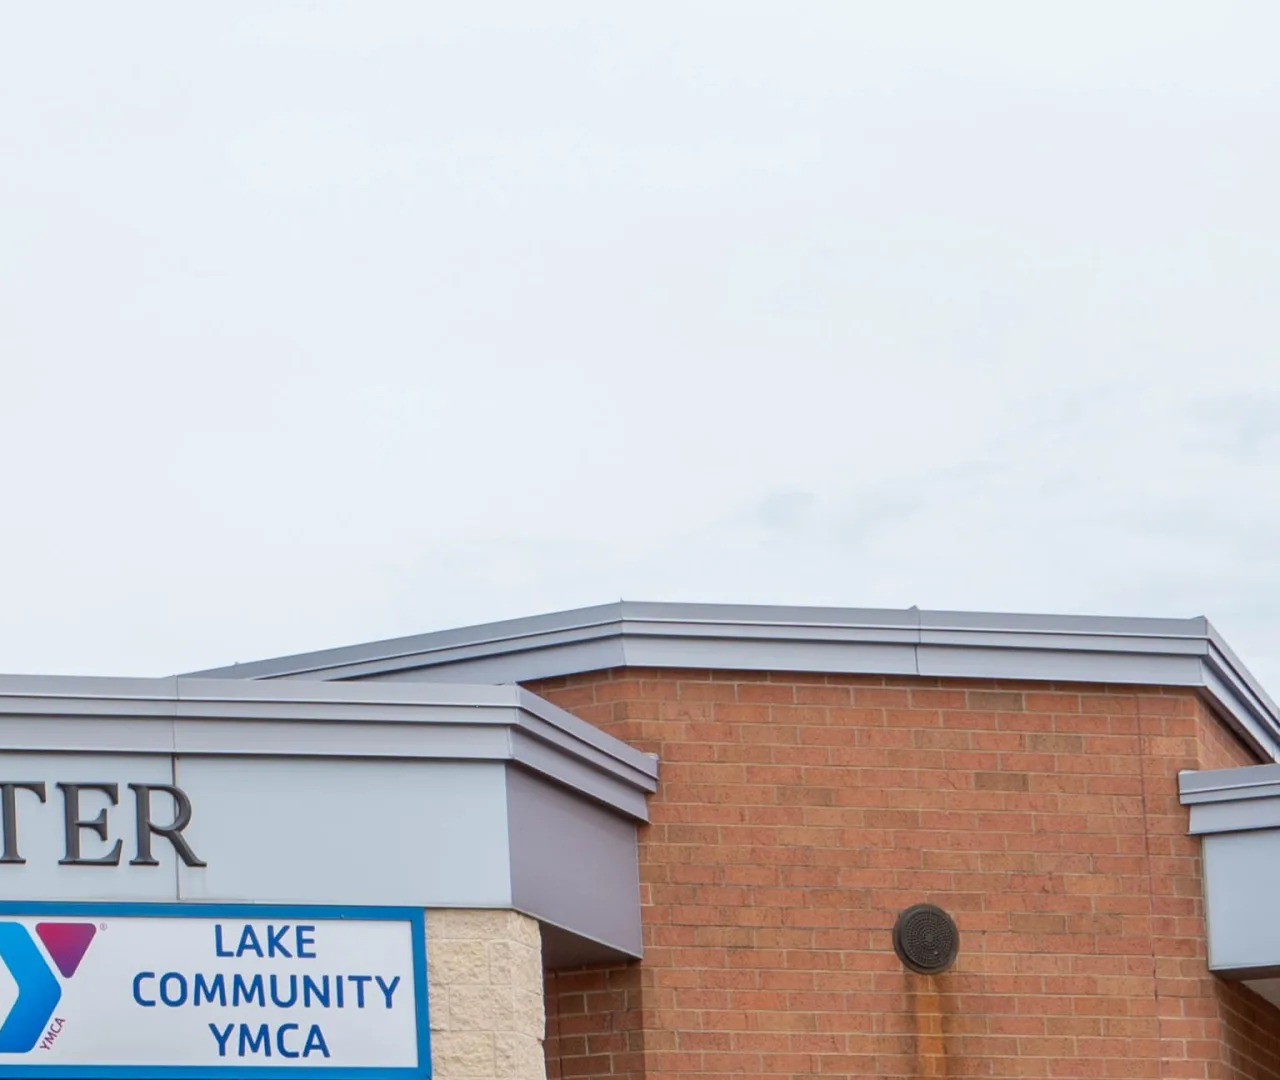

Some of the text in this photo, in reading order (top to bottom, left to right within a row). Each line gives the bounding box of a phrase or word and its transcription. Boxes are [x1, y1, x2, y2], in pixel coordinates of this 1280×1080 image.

[214, 924, 317, 958] LAKE
[132, 971, 401, 1009] COMMUNITY
[39, 1016, 66, 1051] YMCA
[208, 1022, 331, 1058] YMCA
